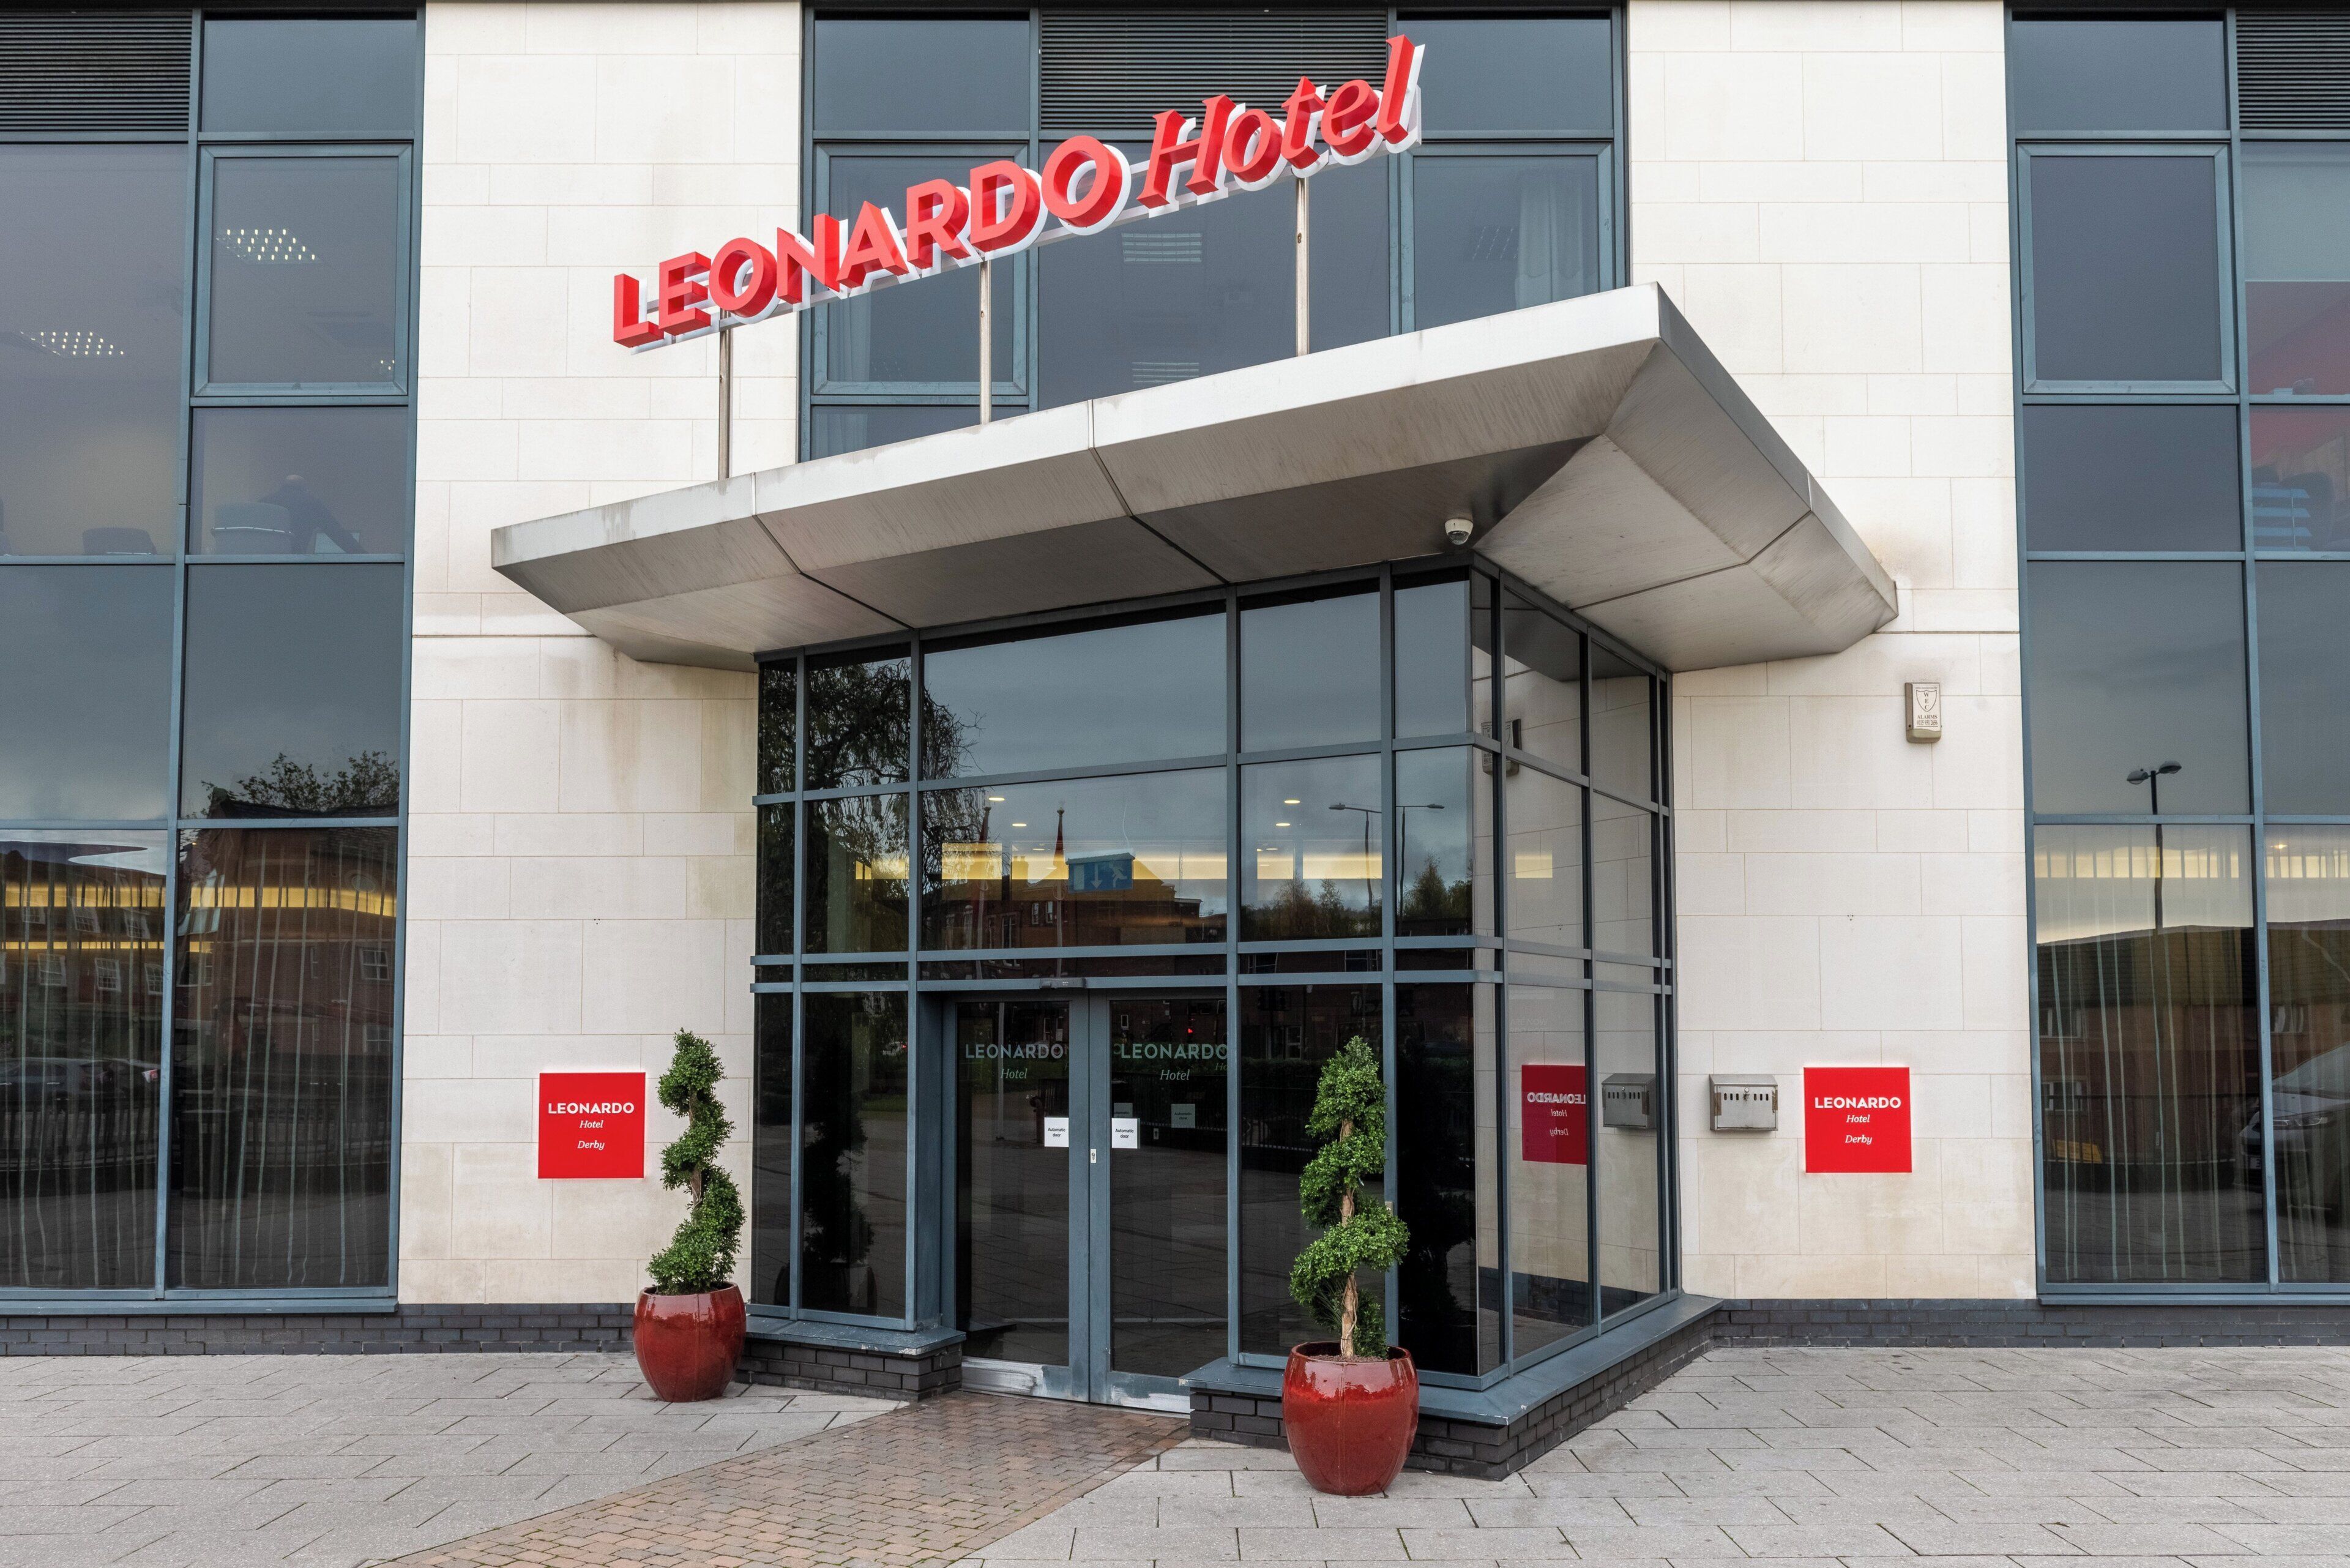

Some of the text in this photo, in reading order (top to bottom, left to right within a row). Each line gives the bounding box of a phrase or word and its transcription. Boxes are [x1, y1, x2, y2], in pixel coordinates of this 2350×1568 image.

[614, 34, 1420, 350] LEONARDO Hotel
[965, 1043, 1064, 1059] LEONARDO
[1121, 1043, 1228, 1059] LEONARDO
[1001, 1068, 1028, 1079] Hotel
[1160, 1069, 1190, 1081] Hotel
[548, 1102, 635, 1114] LEONARDO
[1815, 1097, 1901, 1108] LEONARDO
[579, 1119, 604, 1129] Hotel
[1846, 1114, 1871, 1123] Hotel
[1845, 1134, 1873, 1145] Derby
[577, 1140, 605, 1151] Derby
